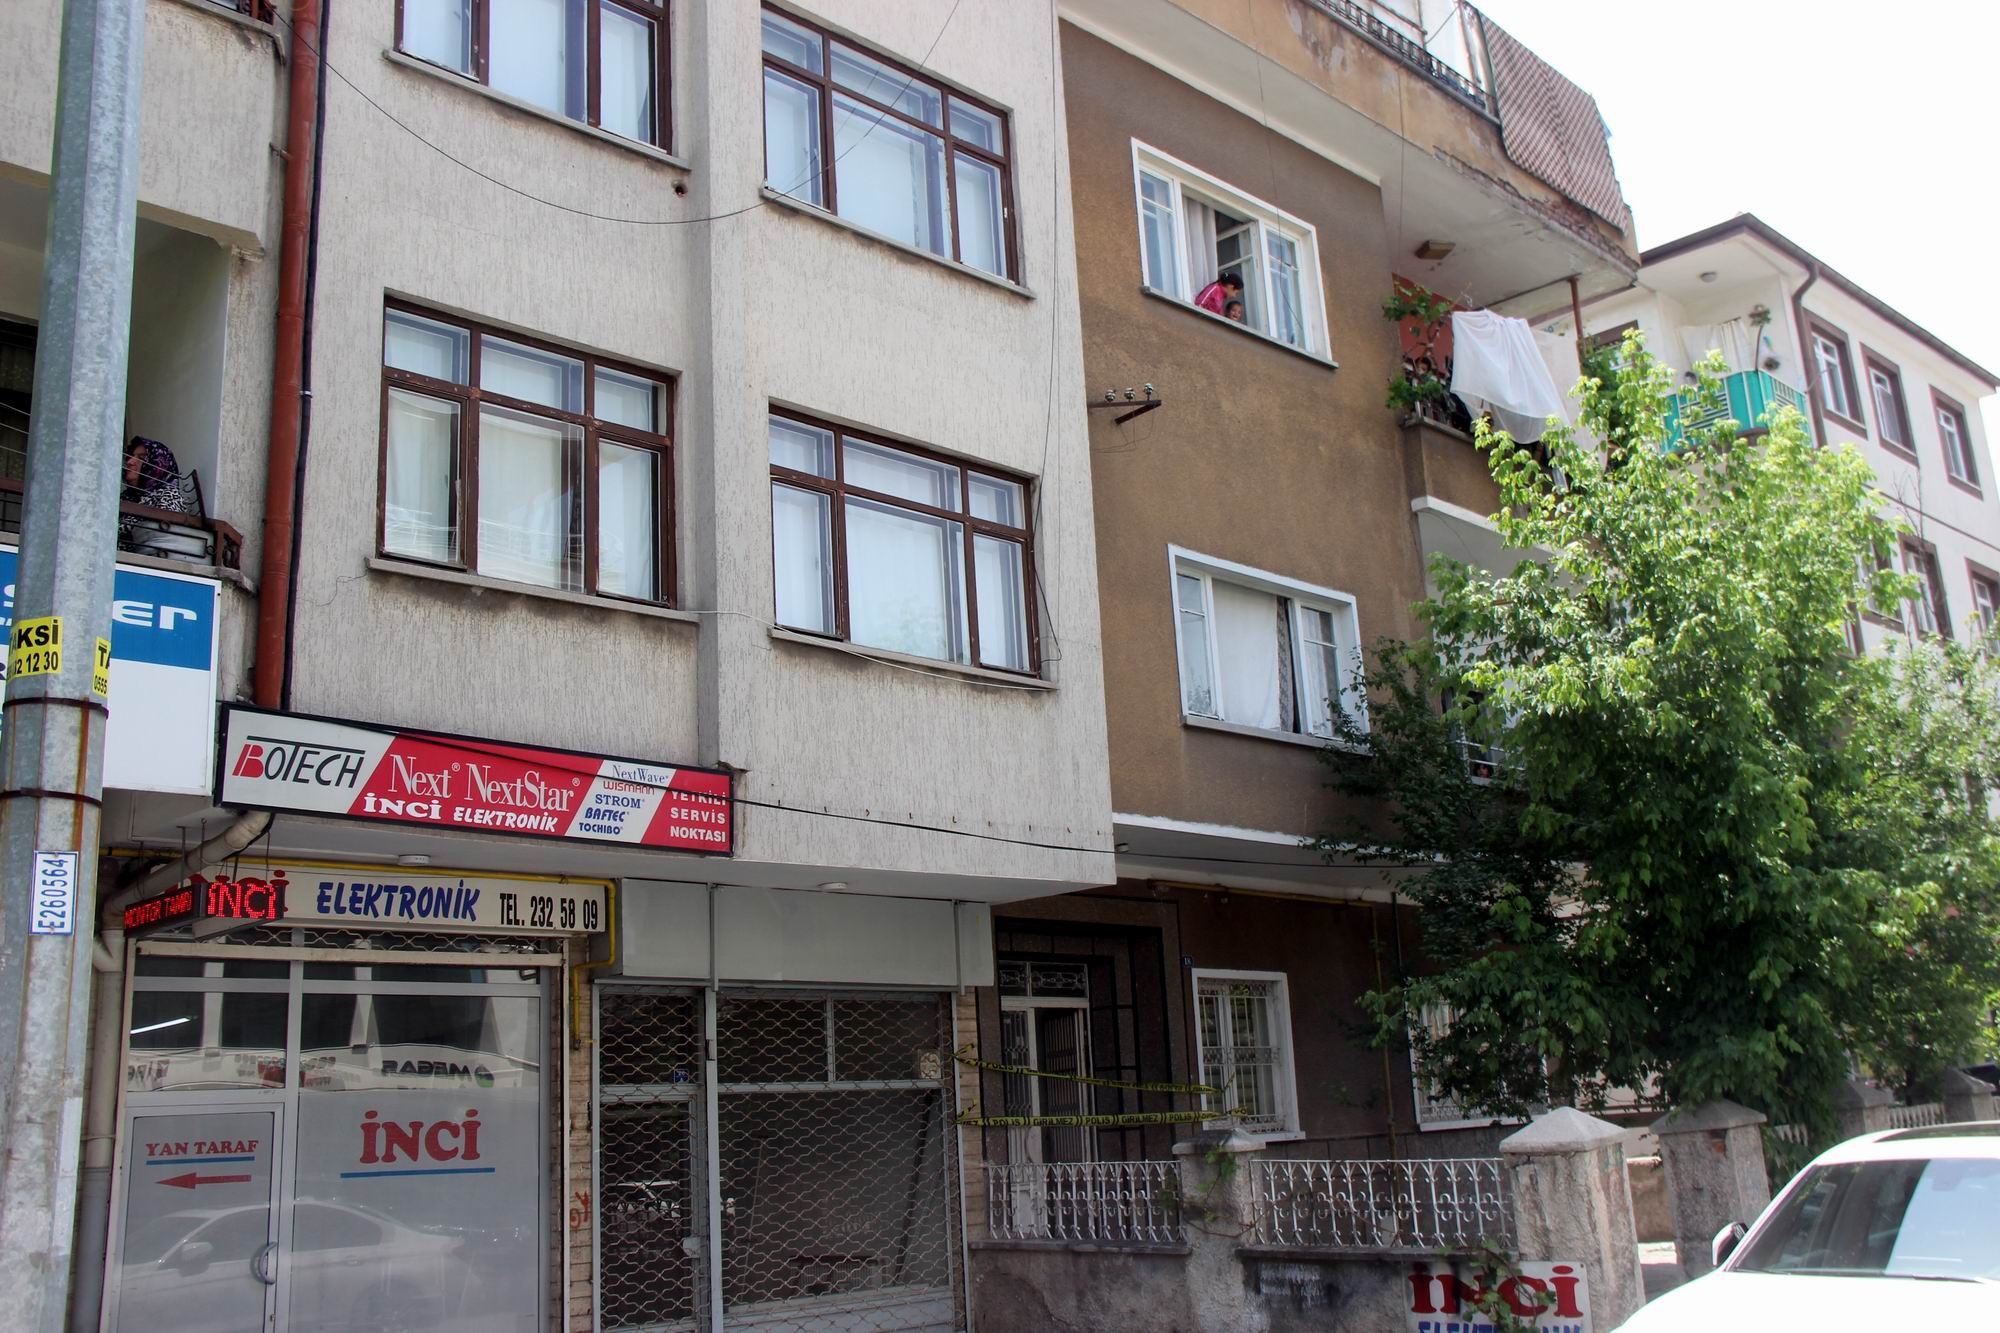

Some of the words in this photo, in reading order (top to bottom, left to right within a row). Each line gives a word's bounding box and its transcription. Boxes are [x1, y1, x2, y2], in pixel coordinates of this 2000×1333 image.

[26, 653, 40, 672] 12
[43, 651, 59, 671] 30
[232, 736, 366, 788] BOTECH
[363, 792, 442, 820] İNCİ
[453, 806, 558, 833] ELEKTRONİK
[595, 794, 641, 809] STROM
[670, 807, 726, 824] SERVİS
[670, 826, 726, 843] NOKTASI
[38, 859, 68, 928] E260564
[316, 879, 481, 922] ELEKTRONİK
[500, 893, 525, 926] TEL.
[530, 896, 554, 928] 232
[560, 898, 576, 929] 58
[583, 899, 598, 930] 09
[145, 1142, 189, 1157] YAN
[194, 1140, 259, 1155] TARAF
[360, 1108, 481, 1164] İNCİ
